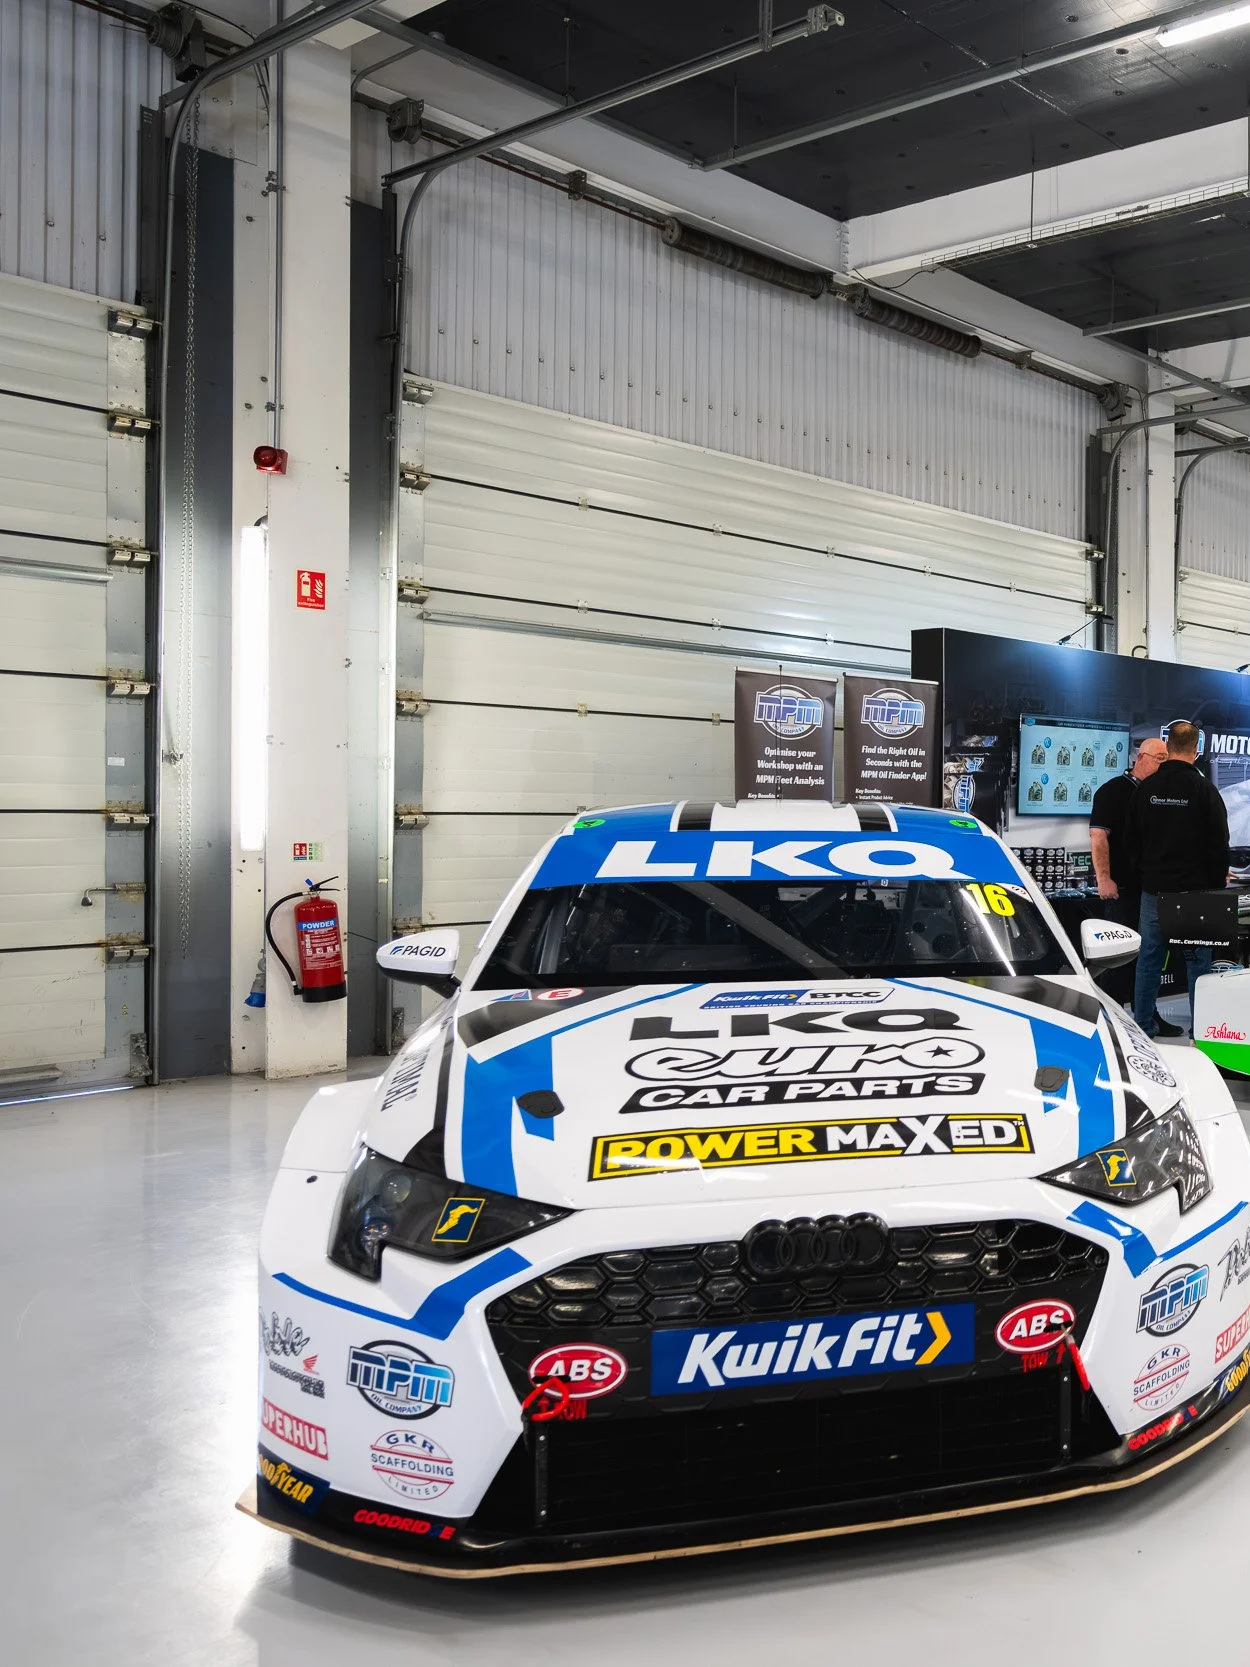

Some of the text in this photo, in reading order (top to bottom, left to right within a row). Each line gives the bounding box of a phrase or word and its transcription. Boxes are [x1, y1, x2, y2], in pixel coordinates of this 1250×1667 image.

[780, 726, 806, 735] COMPANY
[885, 726, 909, 735] COMPANY
[764, 746, 817, 759] Optimise your
[861, 745, 926, 757] Find the Right Oil in
[757, 760, 824, 772] Workshop with an
[865, 758, 923, 768] Seconds with the
[756, 774, 775, 784] MPM
[793, 776, 825, 786] Analysis
[860, 770, 927, 781] MPM Oil Finder App!
[595, 840, 977, 880] LKQ
[966, 883, 1016, 918] 16
[302, 919, 335, 930] POWDER
[402, 945, 446, 959] PAGID
[810, 991, 882, 999] BTCC
[629, 1007, 975, 1041] LKQ
[625, 1037, 986, 1081] euro
[638, 1074, 974, 1110] CAR PARTS
[606, 1128, 818, 1170] POWER
[1009, 1310, 1065, 1341] ABS
[1156, 1309, 1191, 1331] OIL COMPANY
[546, 1357, 613, 1382] ABS
[1021, 1352, 1048, 1373] TOW
[1147, 1346, 1182, 1371] GKR
[1133, 1360, 1191, 1396] SCAFFOLDING
[370, 1393, 423, 1414] OIL COMPANY
[1144, 1383, 1180, 1407] LIMITED
[262, 1401, 327, 1456] UPERHUB
[386, 1432, 436, 1454] GKR
[370, 1452, 454, 1477] SCAFFOLDING
[387, 1475, 439, 1497] LIMITED
